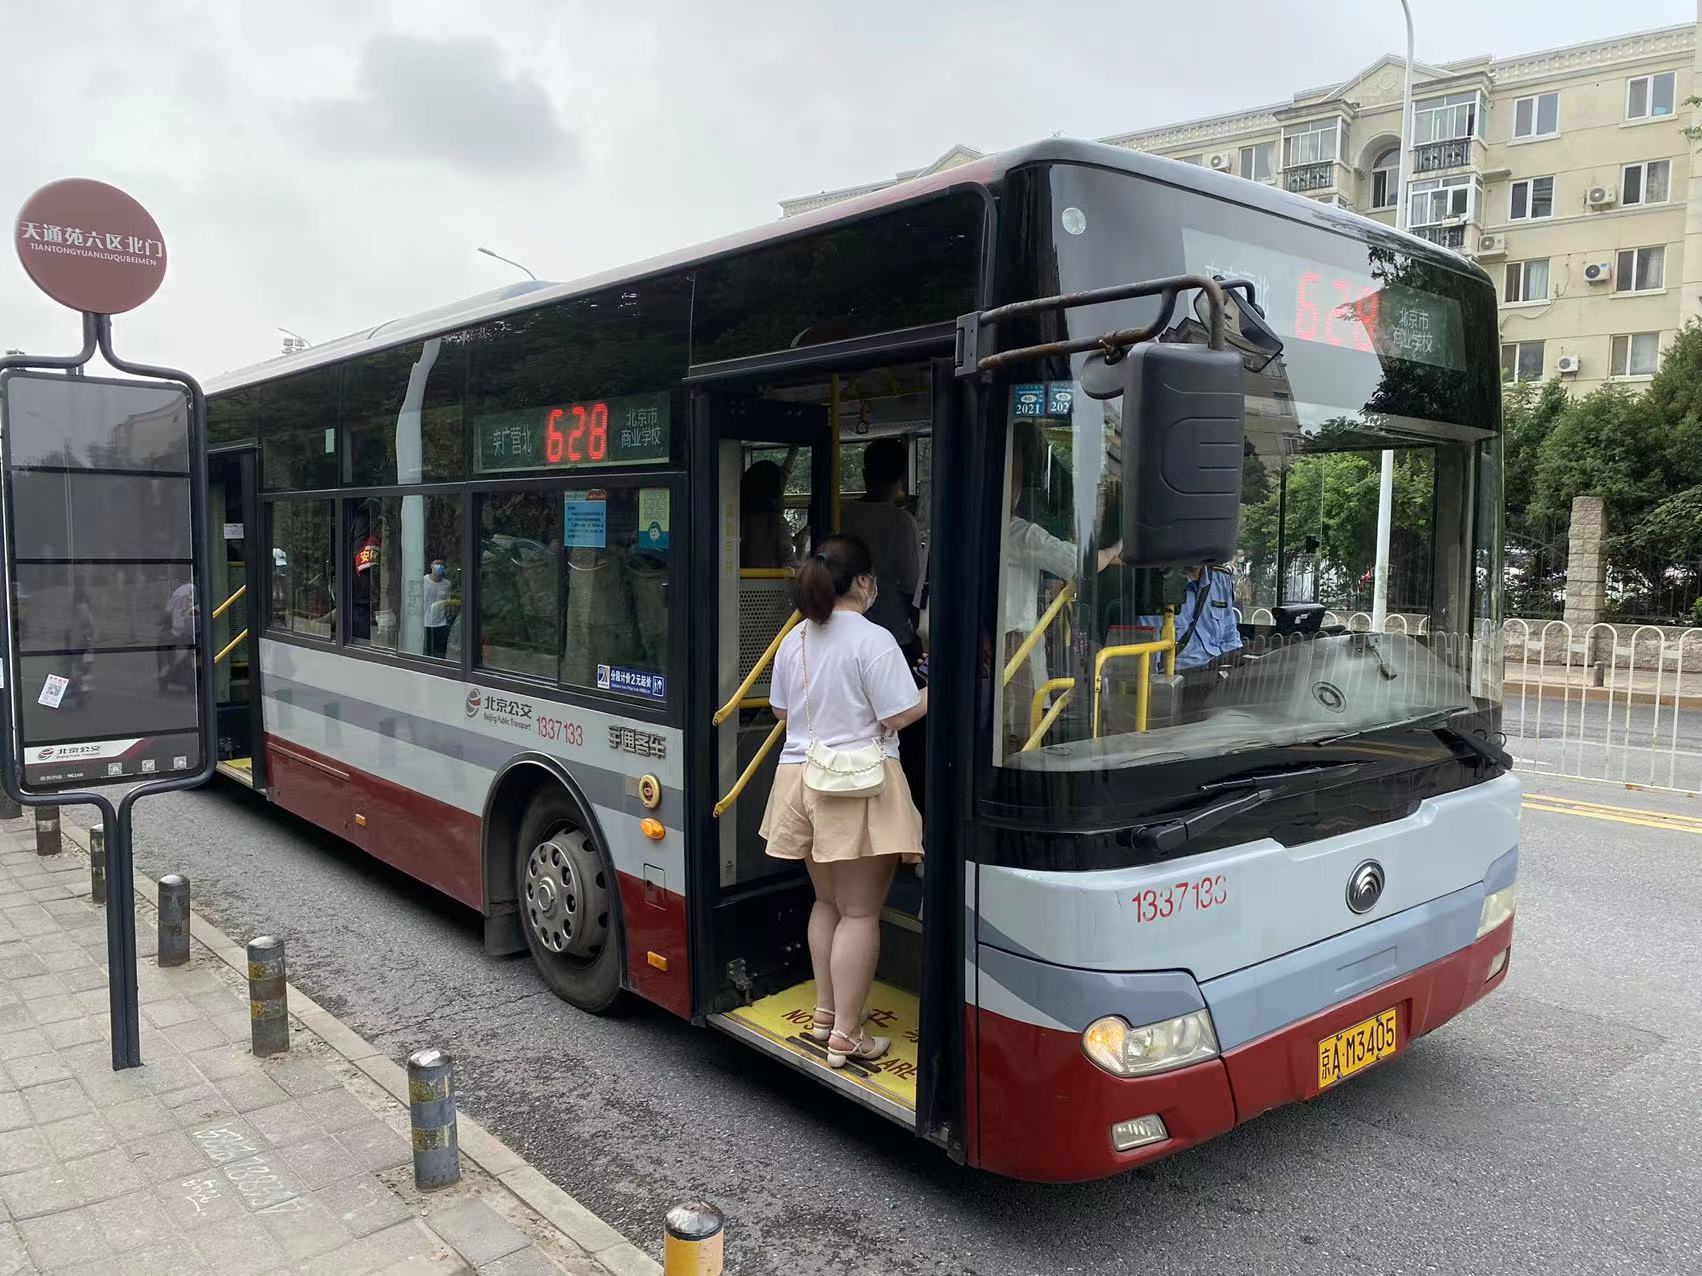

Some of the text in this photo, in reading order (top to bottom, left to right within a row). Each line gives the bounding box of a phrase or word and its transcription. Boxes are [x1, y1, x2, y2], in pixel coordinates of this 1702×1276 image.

[21, 221, 163, 258] 天通苑六区北门
[30, 242, 157, 266] TIANTONGYUANLIUQUBEIMEN
[1295, 271, 1380, 352] 628
[1398, 305, 1430, 331] 北京市
[626, 407, 658, 428] 北京市
[1015, 403, 1040, 415] 2021
[1050, 401, 1070, 413] 202
[492, 424, 533, 457] 来广营北
[545, 402, 609, 463] 628
[620, 426, 662, 448] 商业学校
[484, 696, 533, 719] 北京公交
[483, 713, 531, 731] Beijing Public Transport
[536, 716, 583, 746] 1337133
[58, 745, 101, 755] 北京公交
[608, 726, 667, 760] 宇通客车
[1131, 875, 1227, 923] 1337133
[780, 1008, 813, 1024] NO
[877, 1058, 917, 1080] ARE
